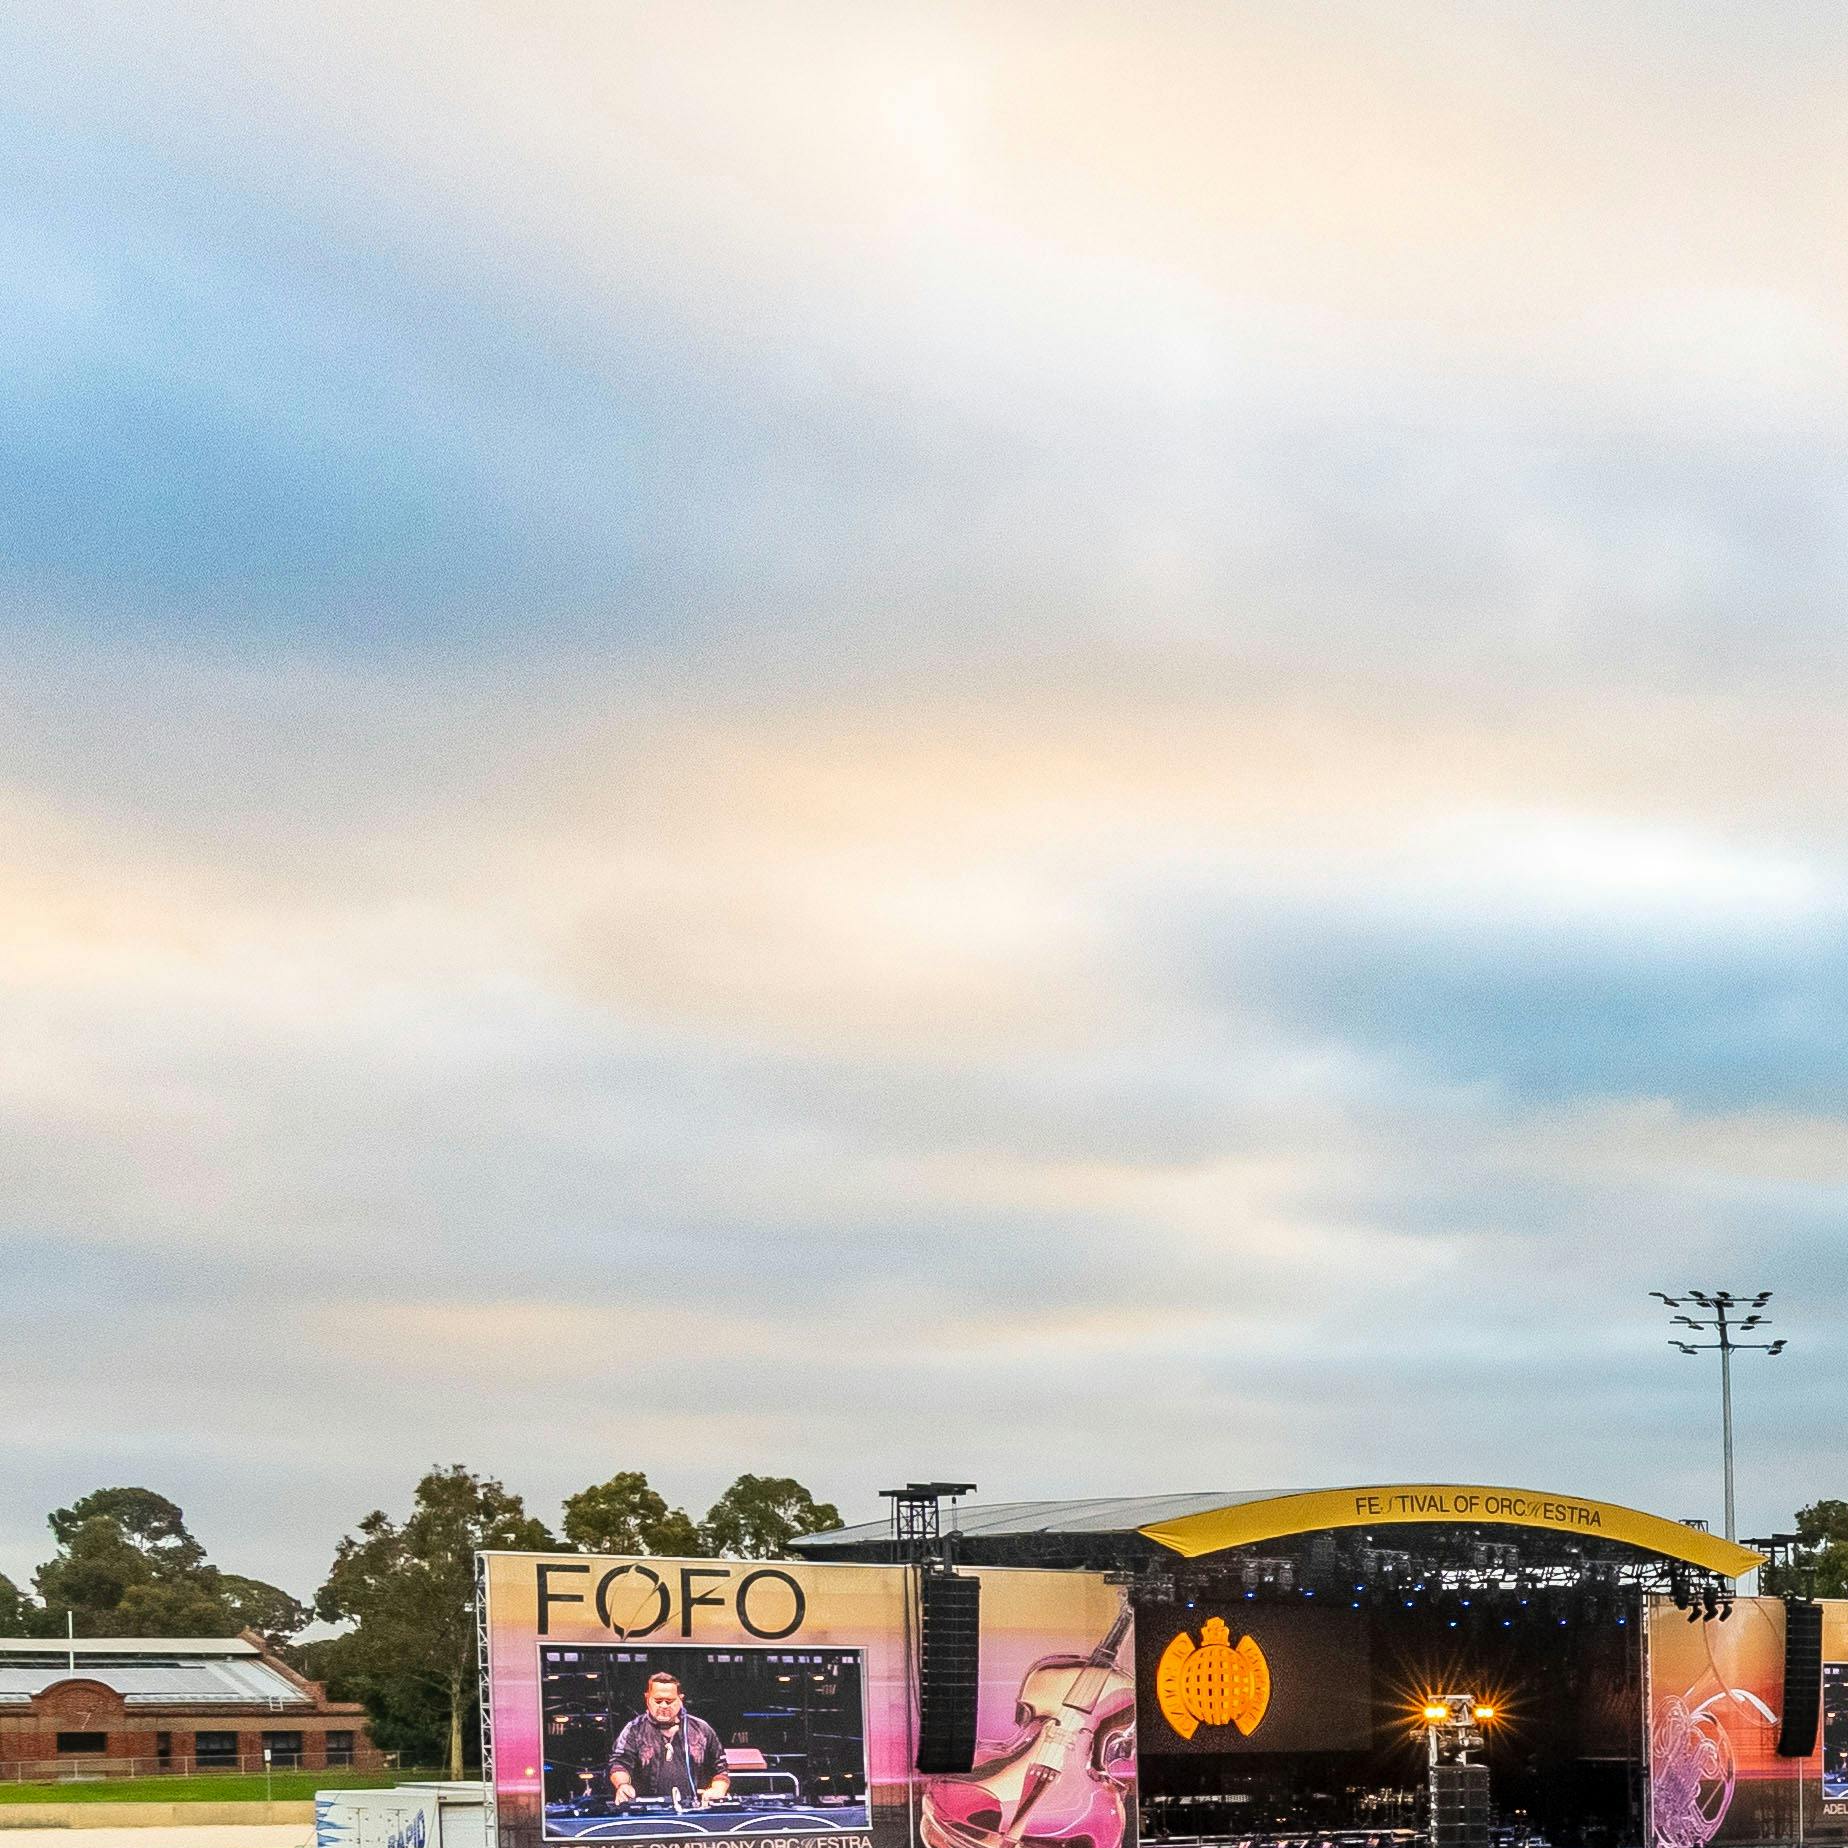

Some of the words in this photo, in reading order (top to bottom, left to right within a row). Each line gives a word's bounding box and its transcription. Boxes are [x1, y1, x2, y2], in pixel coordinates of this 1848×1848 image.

[1355, 1494, 1450, 1515] FESTIVAL
[1454, 1494, 1480, 1515] OF
[1485, 1496, 1602, 1528] ORCHESTRA
[536, 1563, 806, 1640] FOFO
